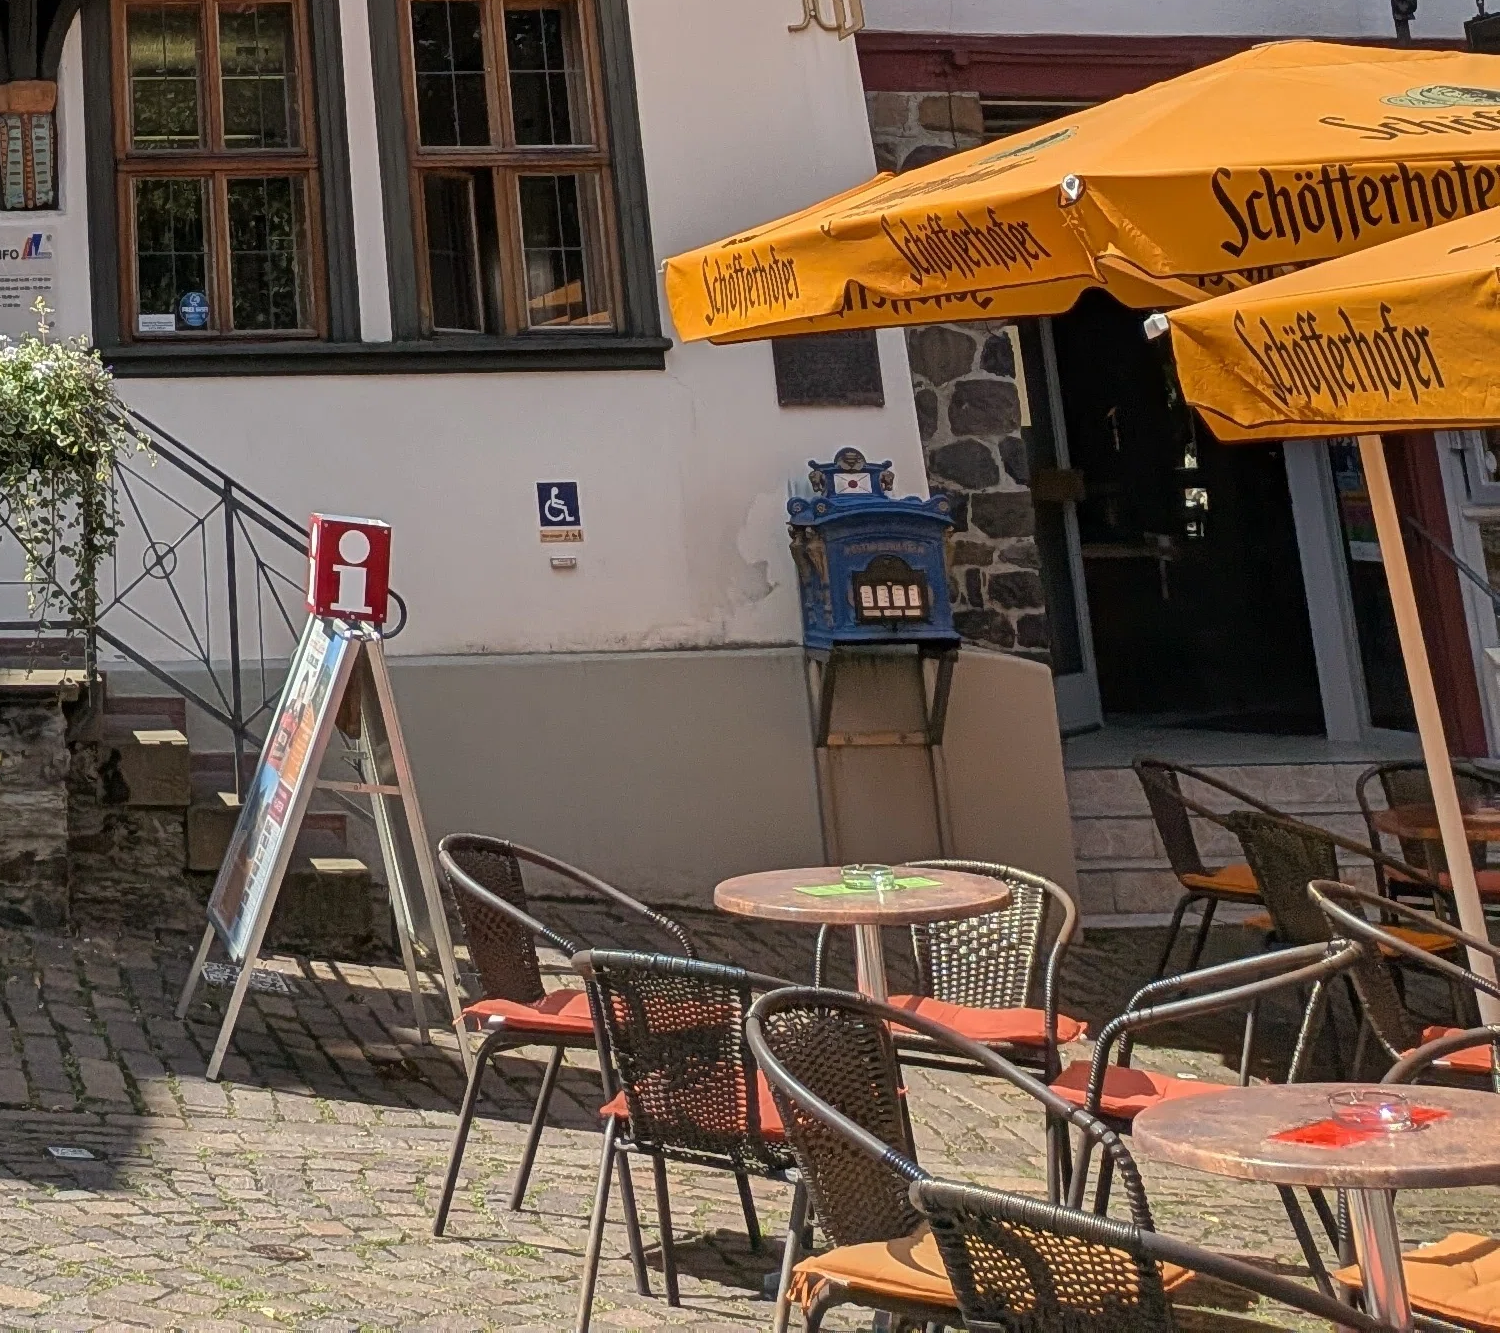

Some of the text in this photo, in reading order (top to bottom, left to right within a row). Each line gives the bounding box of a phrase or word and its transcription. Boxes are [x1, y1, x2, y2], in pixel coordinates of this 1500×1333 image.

[880, 206, 1052, 287] Schöfferhofer
[1211, 160, 1500, 258] Schöfferhofe
[702, 244, 800, 327] Schöfferhofer
[1233, 301, 1445, 408] Schöfferhofer
